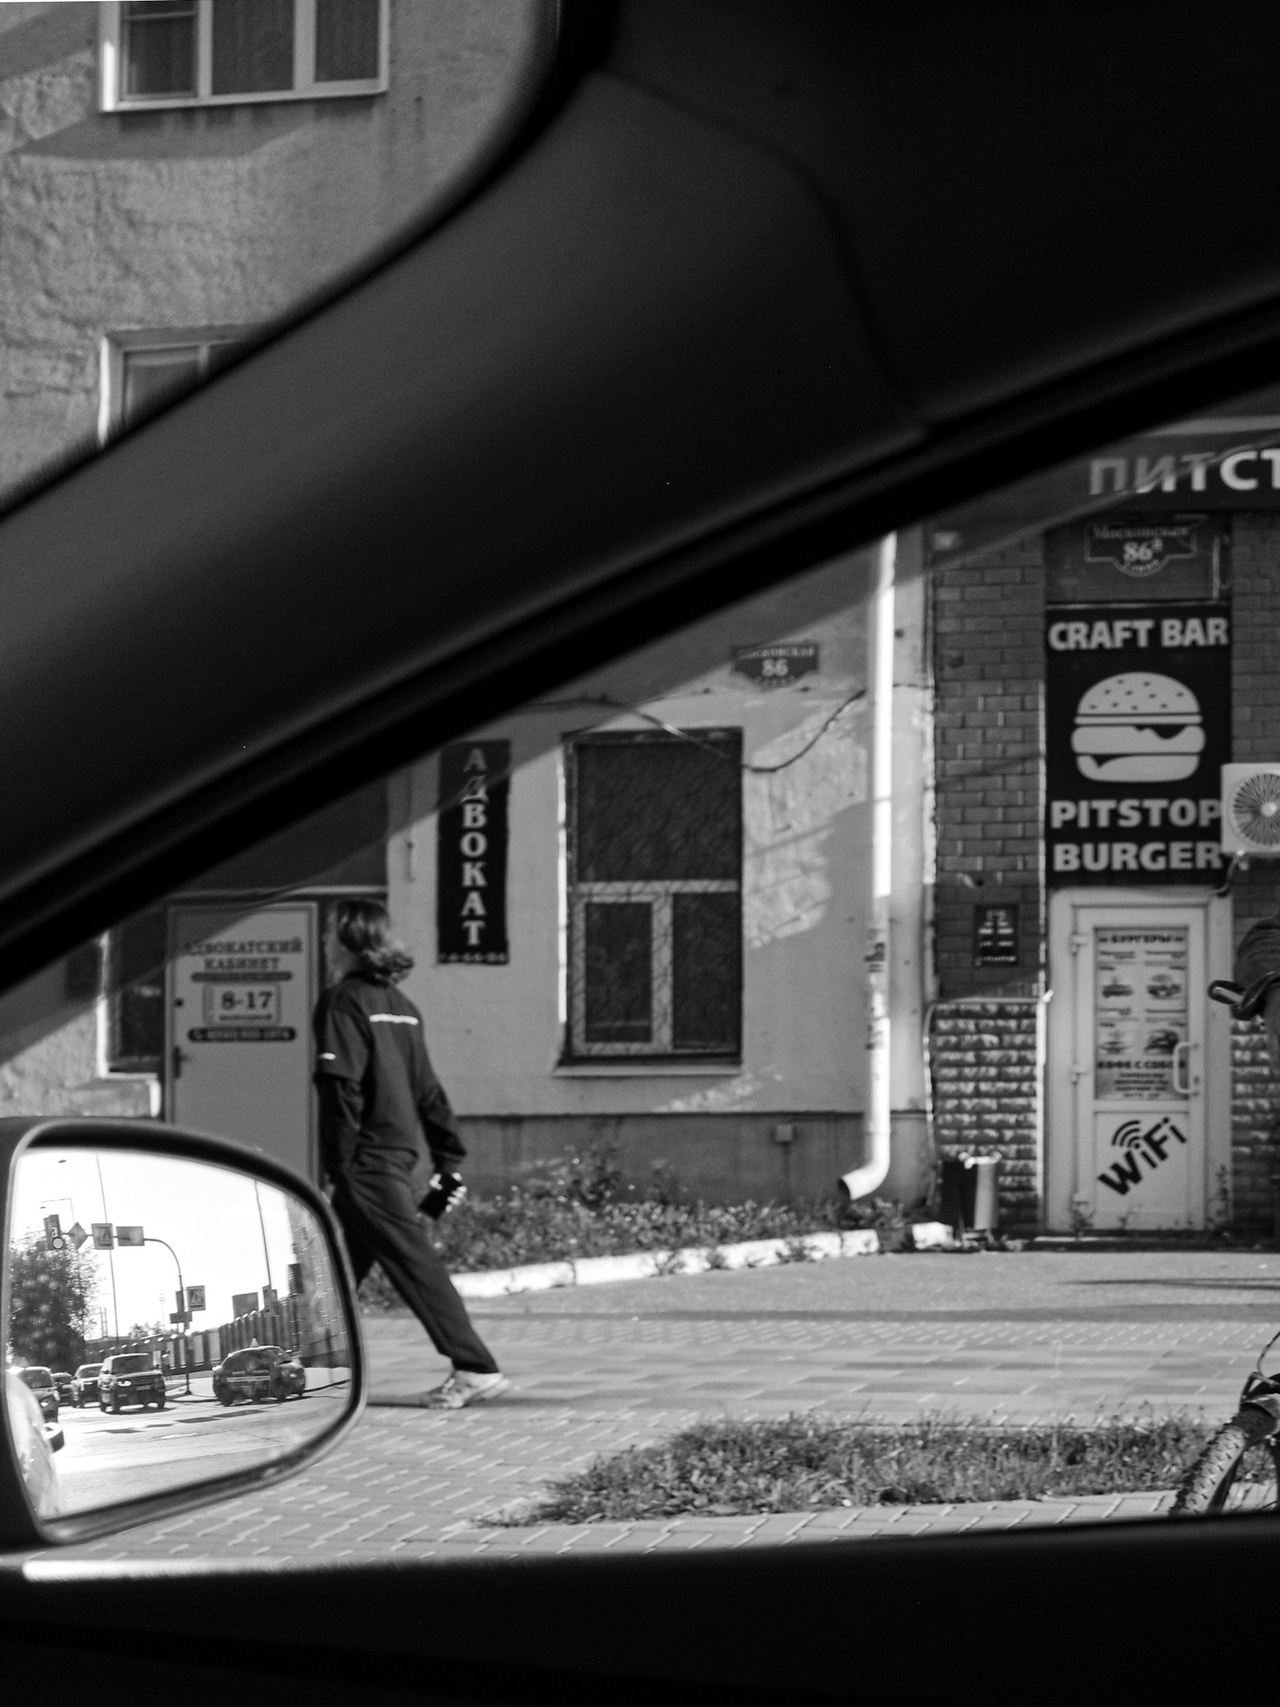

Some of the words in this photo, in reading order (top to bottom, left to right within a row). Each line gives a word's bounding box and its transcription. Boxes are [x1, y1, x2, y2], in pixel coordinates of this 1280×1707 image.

[1049, 619, 1154, 650] CRAFT
[1162, 618, 1229, 647] BAR
[1051, 799, 1222, 829] PITSTOP
[460, 748, 488, 946] АДВОКАТ
[1053, 842, 1223, 872] BURGER
[221, 991, 272, 1010] 8-17
